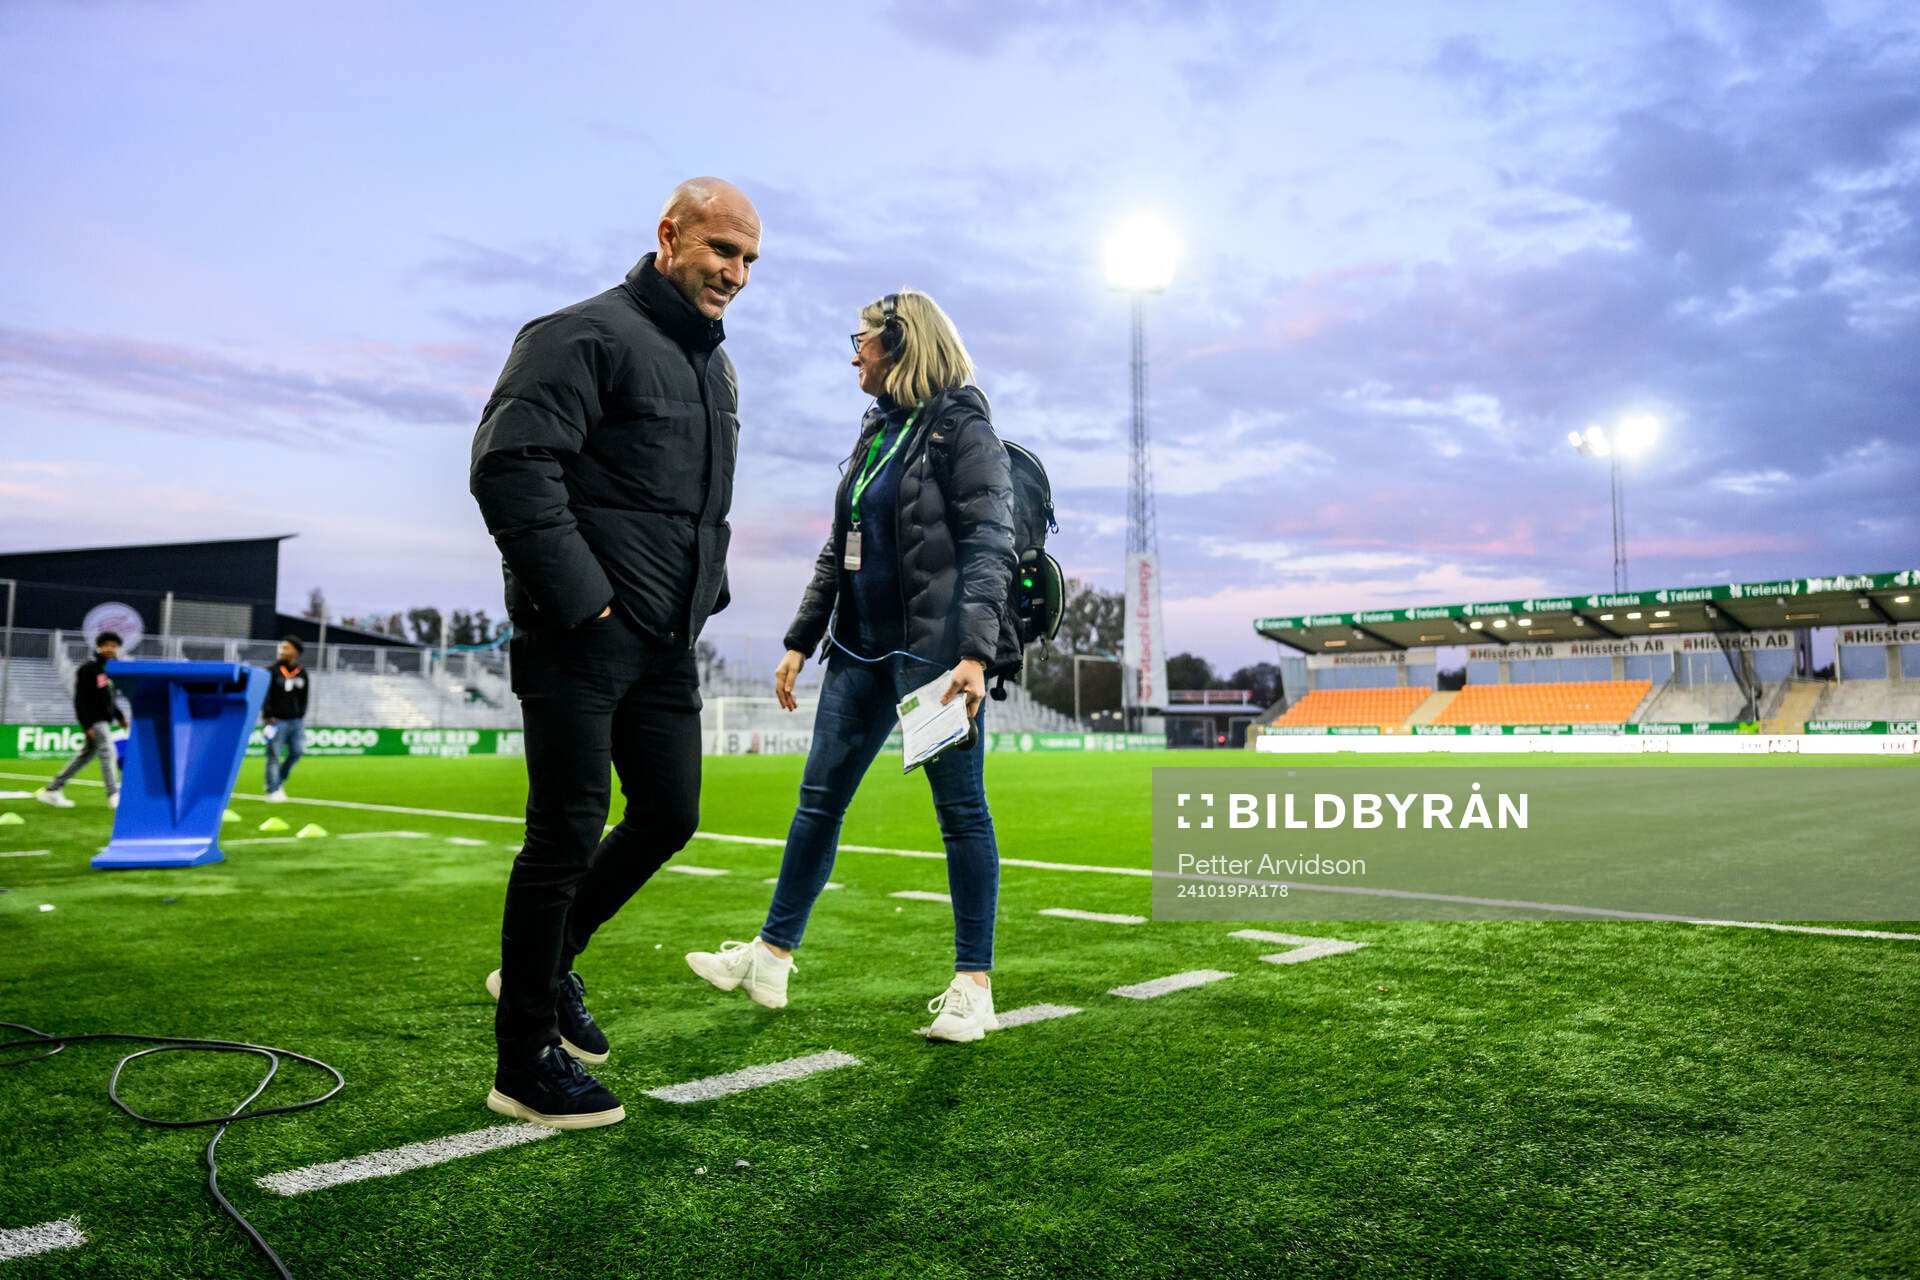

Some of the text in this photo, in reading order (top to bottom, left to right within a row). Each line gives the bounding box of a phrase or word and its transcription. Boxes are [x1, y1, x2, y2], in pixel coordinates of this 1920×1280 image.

[1670, 589, 1713, 603] Telexia
[1744, 583, 1790, 597] Telexia
[1535, 599, 1573, 611] Telexia
[1600, 594, 1640, 607] Telexia
[1474, 604, 1510, 616] Telexia
[1579, 639, 1664, 657] Hisstech AB
[1693, 634, 1789, 650] Hisstech AB
[1391, 652, 1406, 663] AB
[1477, 645, 1554, 659] Hisstech AB
